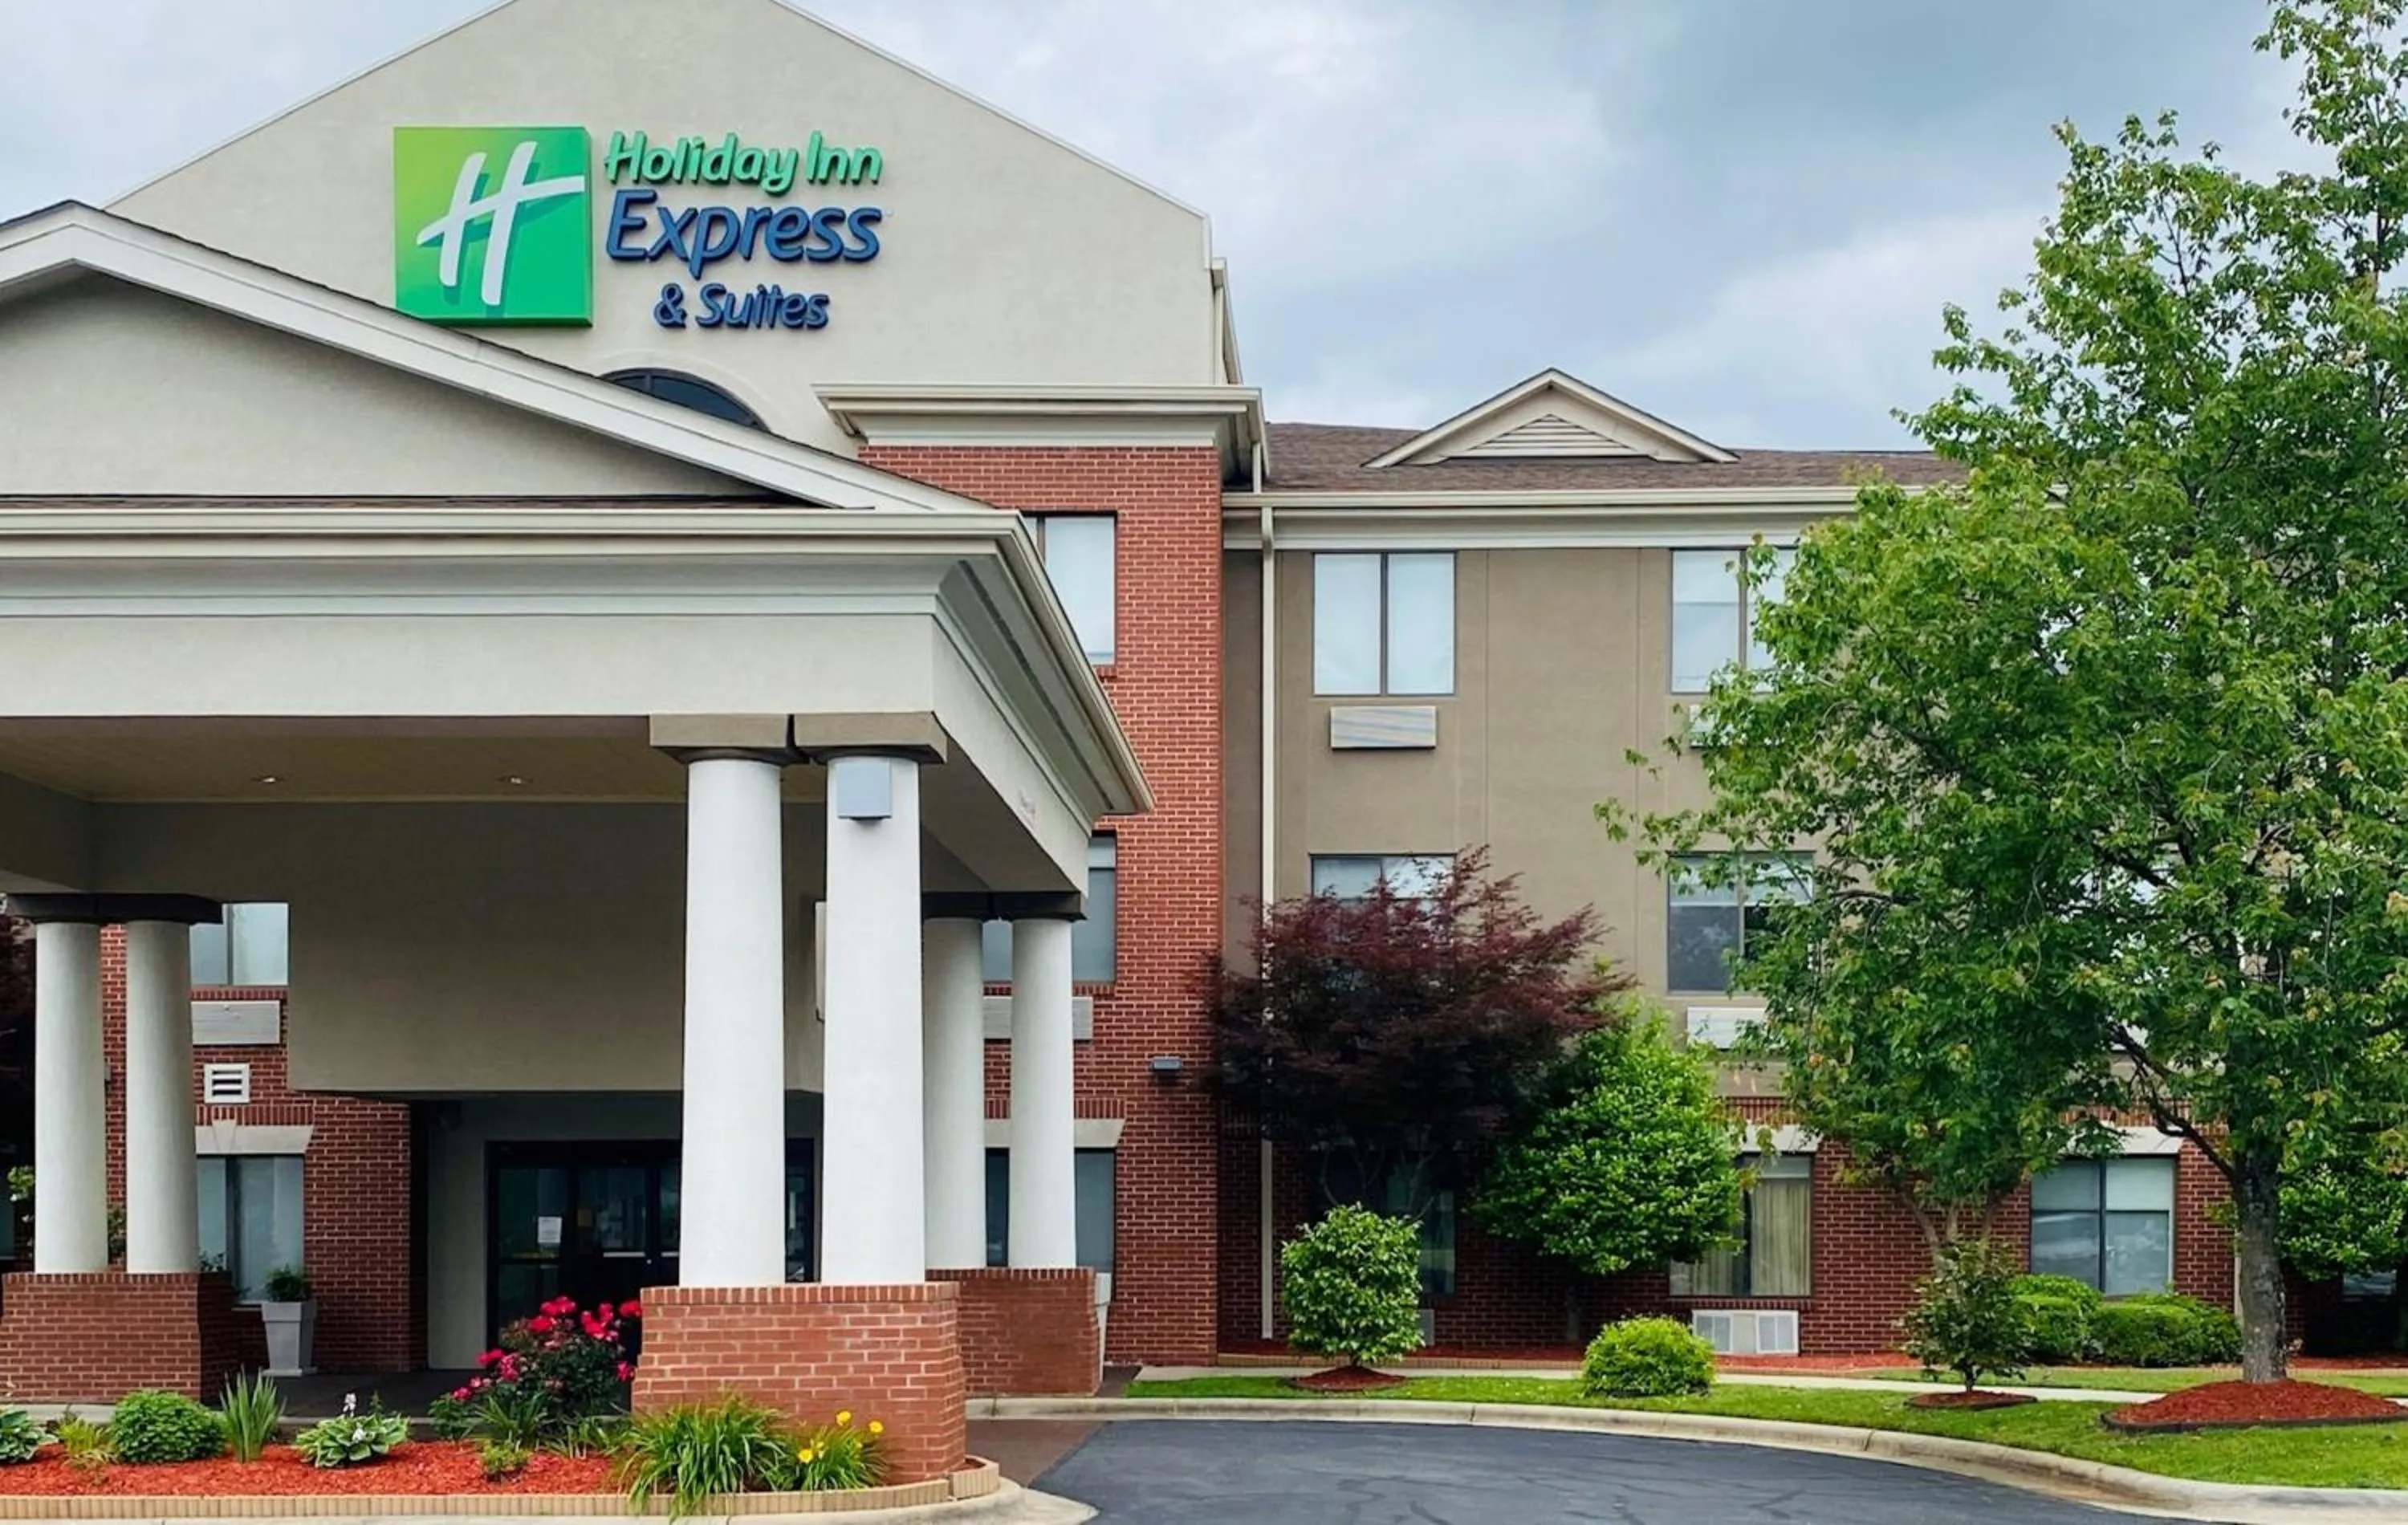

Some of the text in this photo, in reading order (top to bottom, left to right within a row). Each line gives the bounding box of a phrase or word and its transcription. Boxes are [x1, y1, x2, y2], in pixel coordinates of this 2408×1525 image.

[604, 130, 882, 195] Holiday Inn
[417, 140, 585, 306] H
[604, 188, 882, 280] Express
[653, 283, 831, 331] & Suites
